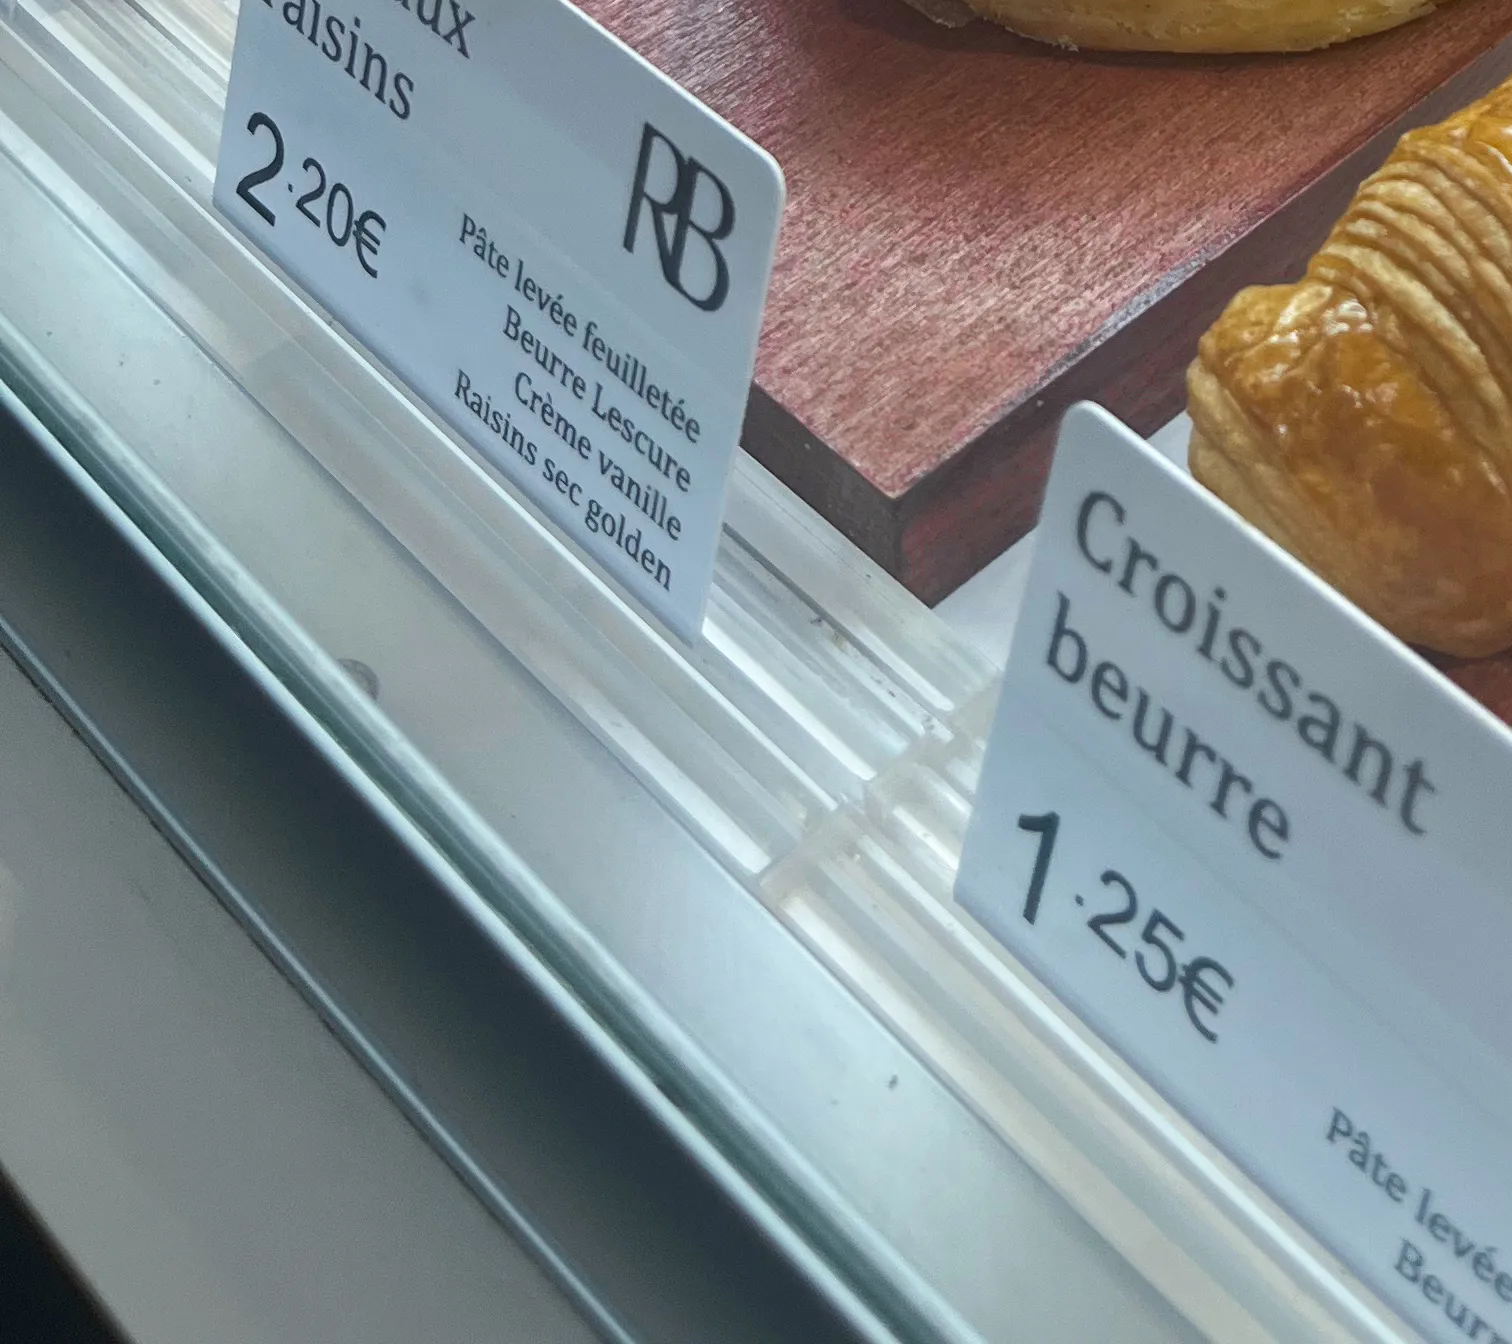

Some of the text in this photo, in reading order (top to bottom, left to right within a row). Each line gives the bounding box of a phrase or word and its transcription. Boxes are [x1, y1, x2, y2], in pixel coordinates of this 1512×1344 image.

[622, 122, 735, 312] RB
[459, 213, 700, 444] Pâte levée feuilletée
[502, 304, 691, 493] Beurre Lescure
[453, 369, 671, 592] Raisins sec golden
[515, 372, 682, 541] Crème vanille
[1045, 591, 1292, 863] beurre
[1076, 490, 1438, 837] Croissant
[1326, 1106, 1407, 1203] Pâte
